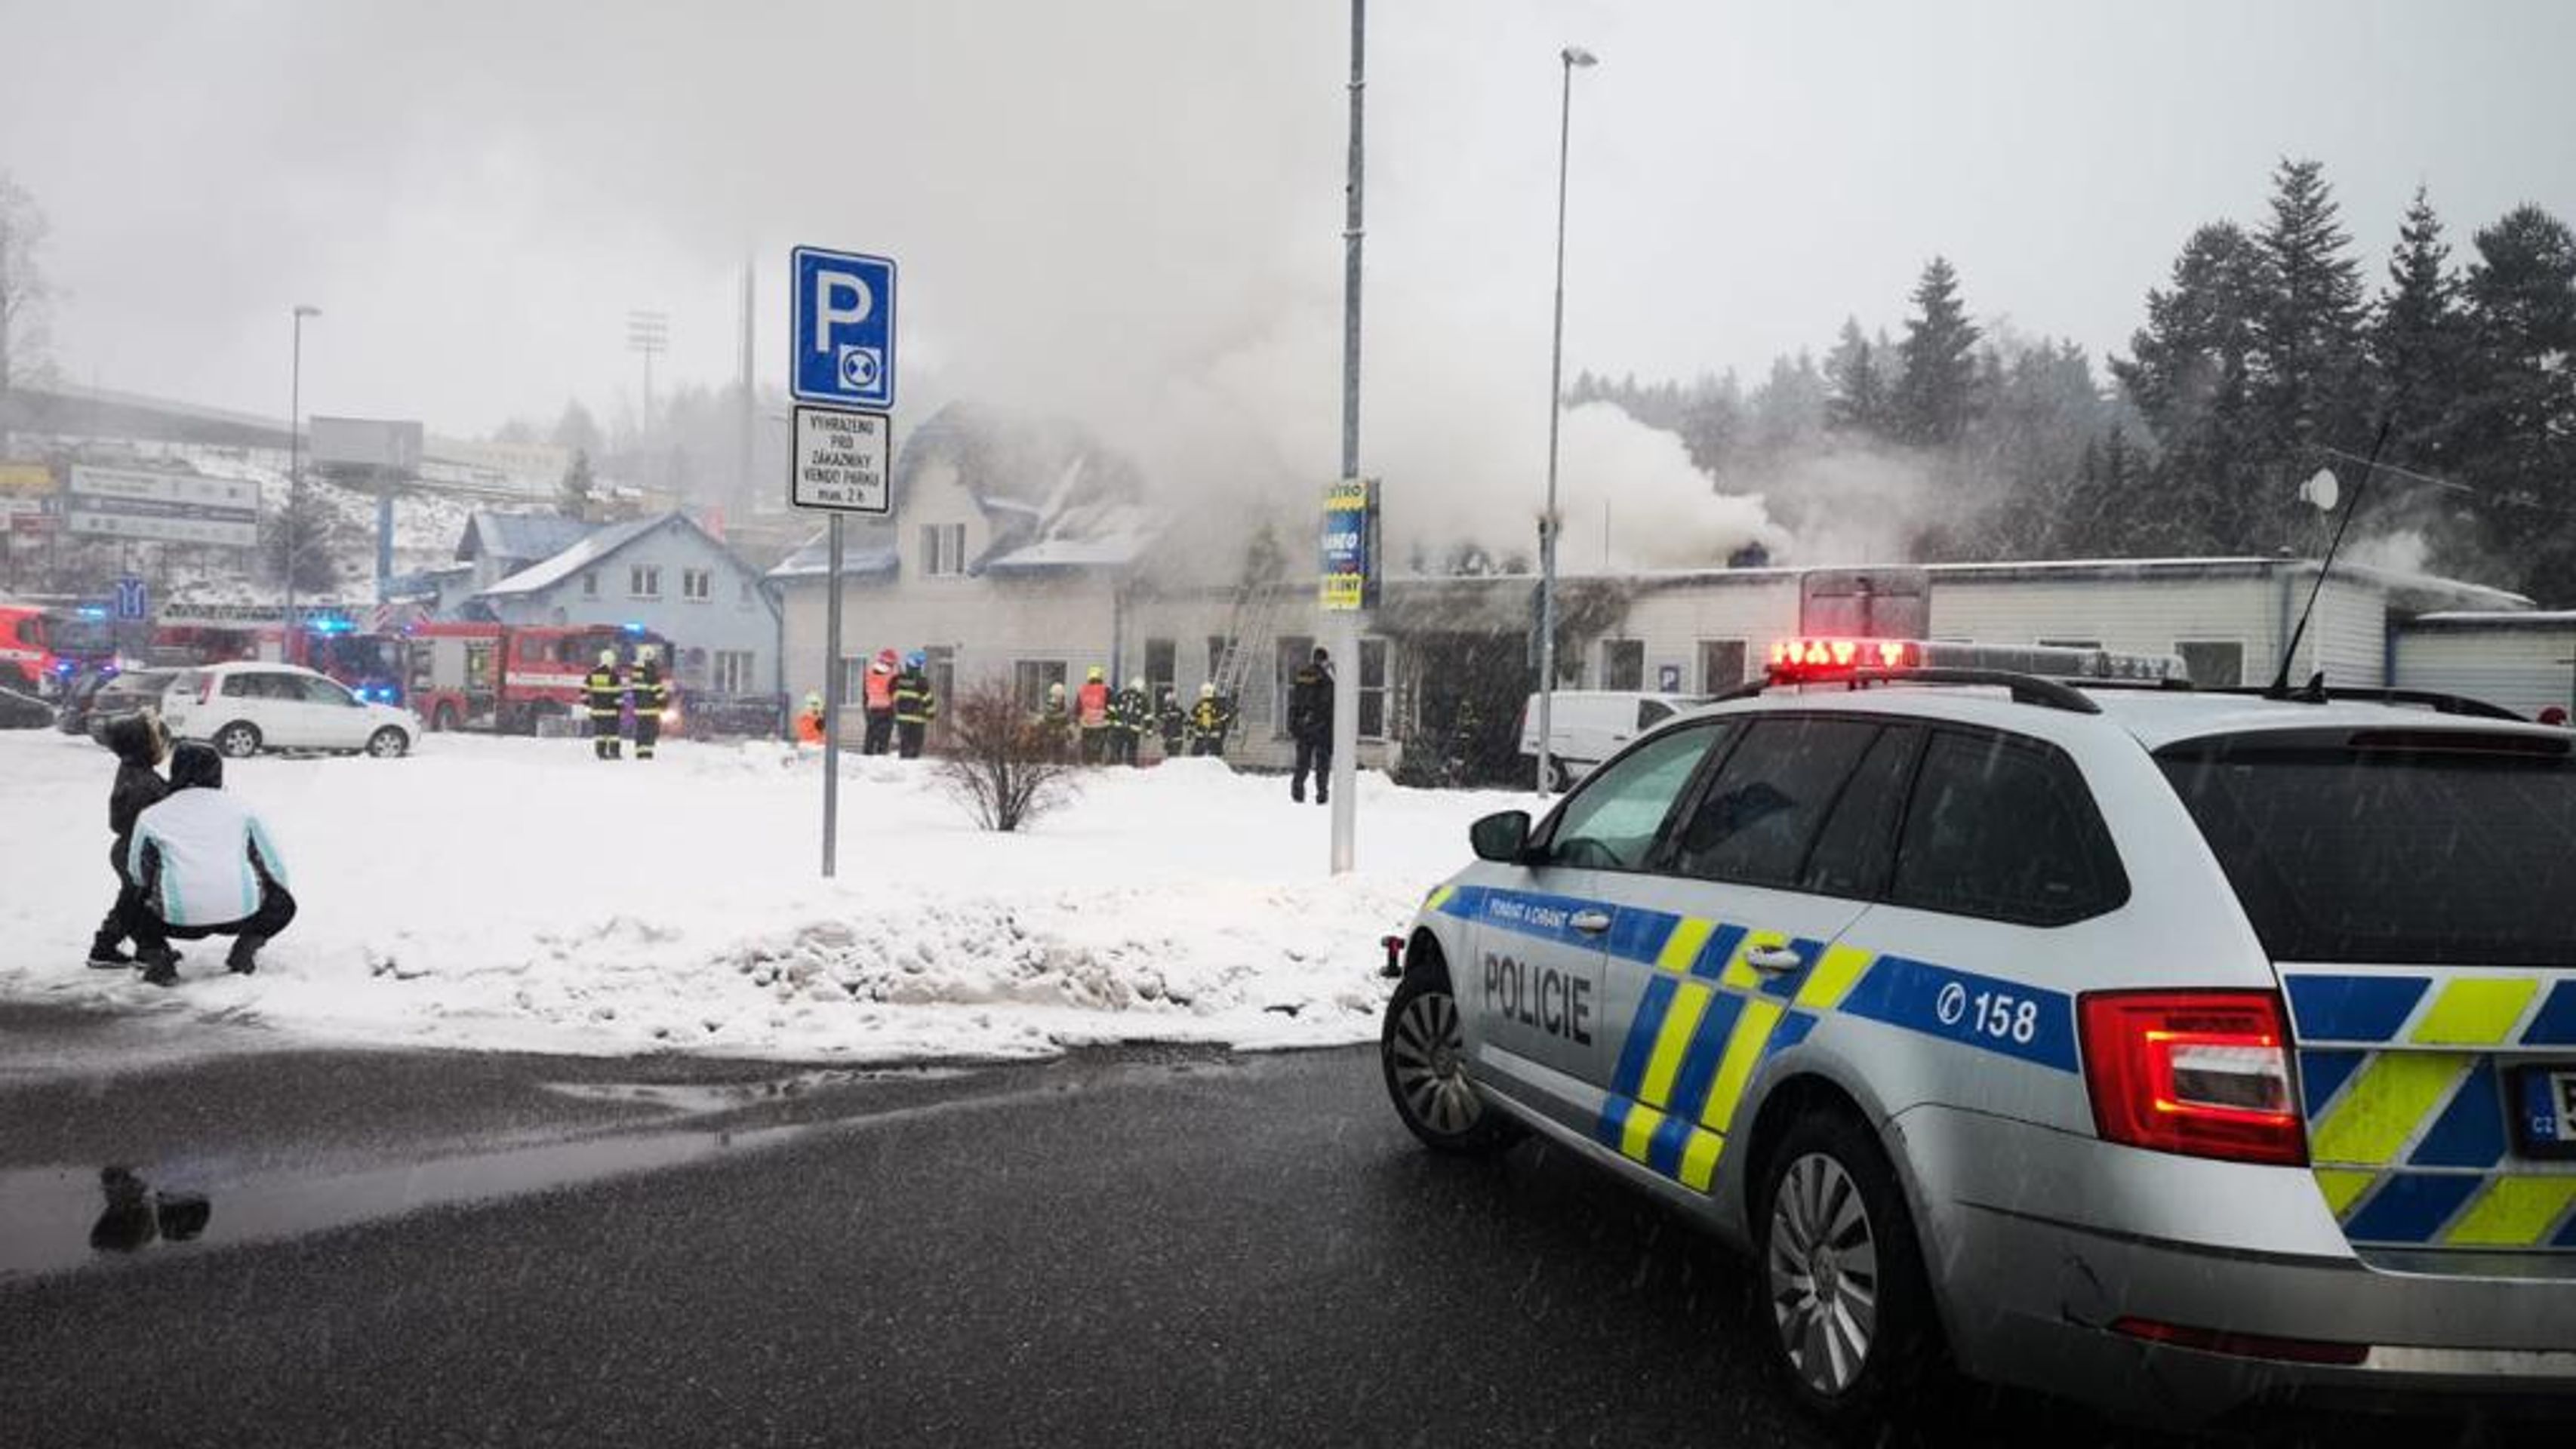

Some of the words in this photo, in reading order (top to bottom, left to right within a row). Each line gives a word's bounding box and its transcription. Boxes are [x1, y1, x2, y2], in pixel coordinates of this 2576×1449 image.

[815, 269, 872, 353] P
[830, 435, 854, 449] PRO
[1484, 951, 1591, 1047] POLICIE
[1974, 992, 2037, 1043] 158
